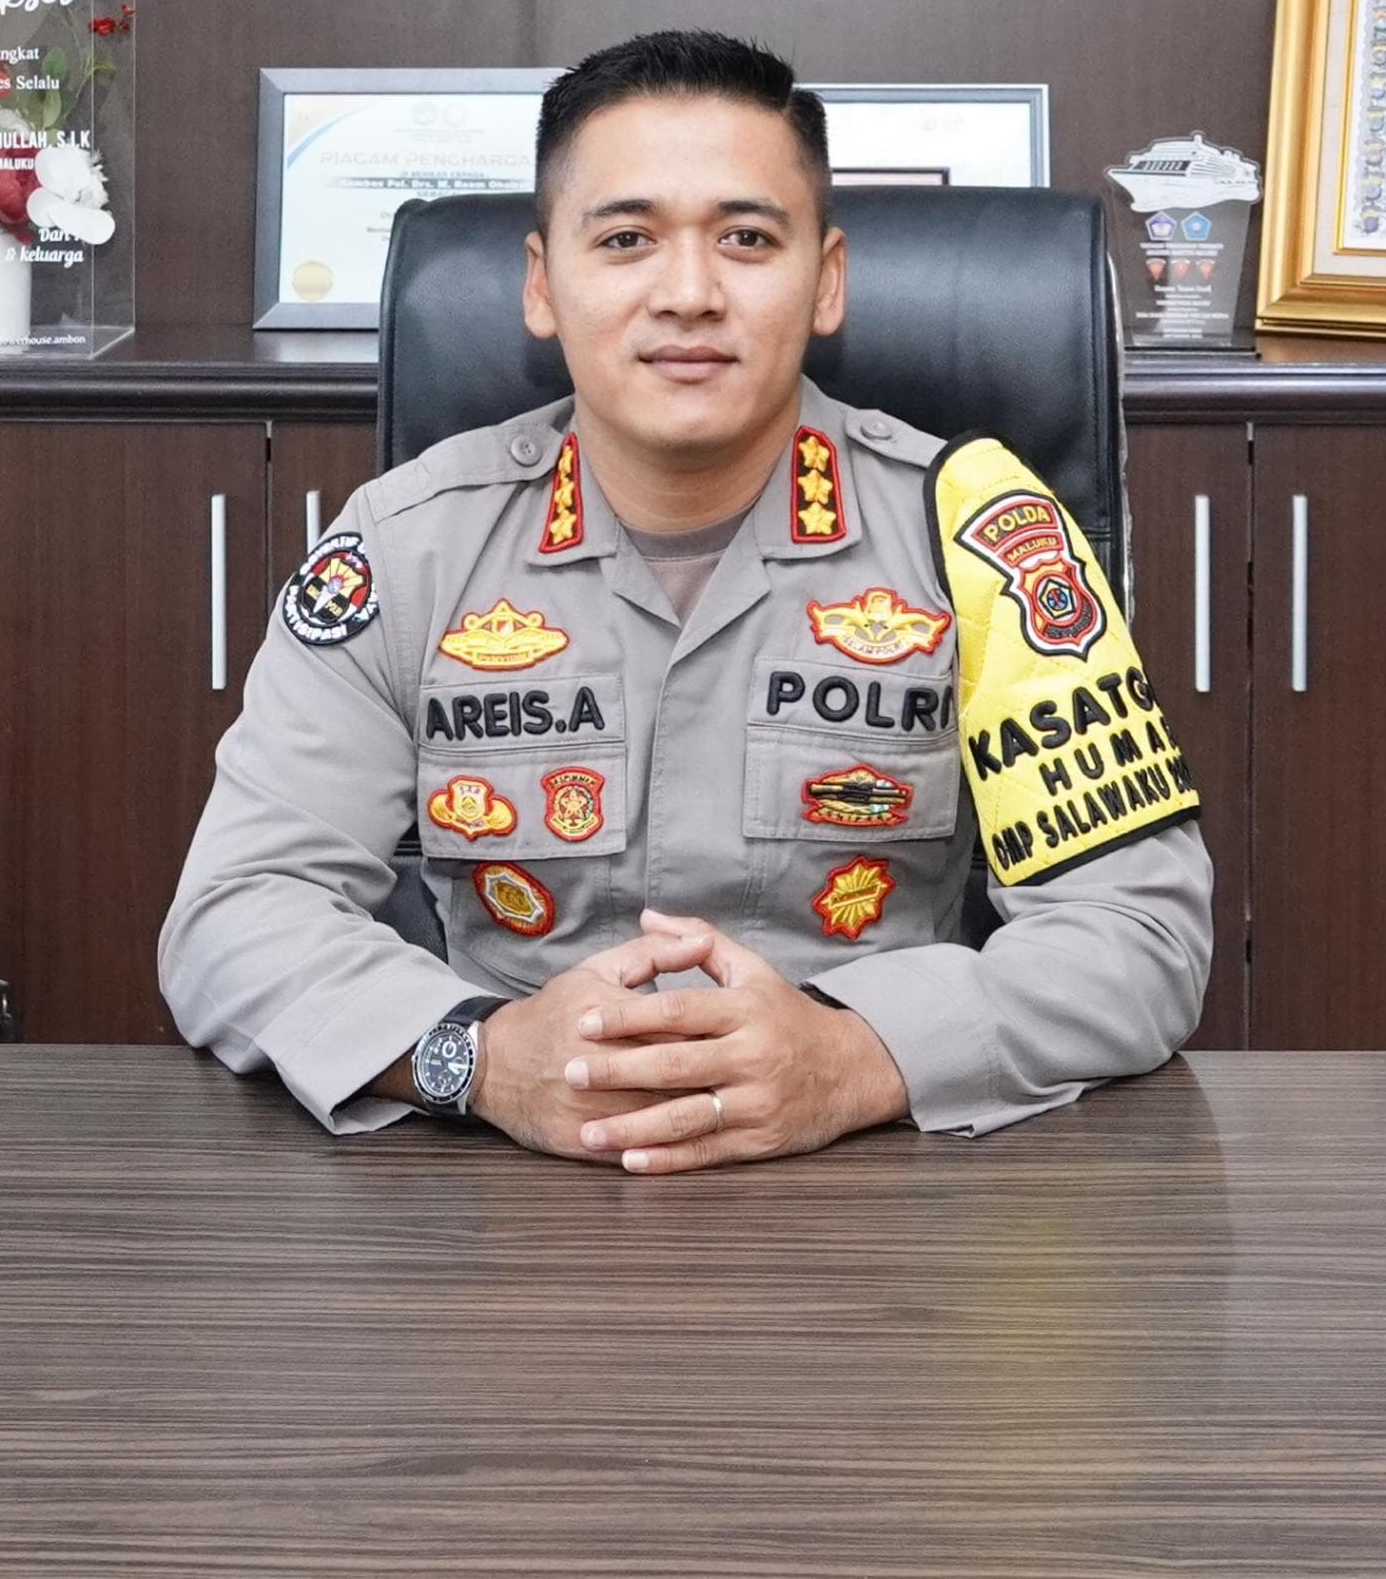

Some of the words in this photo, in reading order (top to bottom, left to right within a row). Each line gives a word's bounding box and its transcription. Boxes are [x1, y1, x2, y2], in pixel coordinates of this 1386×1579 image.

[16, 74, 59, 90] Selalu
[320, 153, 399, 166] PIAGAM
[405, 153, 533, 167] PENGHARGA
[20, 247, 84, 268] keluarga
[983, 505, 1051, 543] POLDA
[1007, 536, 1057, 562] MALUKU
[426, 686, 605, 741] AREIS.A
[766, 671, 954, 732] POLRI
[969, 666, 1156, 781] KASATG
[1037, 763, 1171, 848] SALAWAKU
